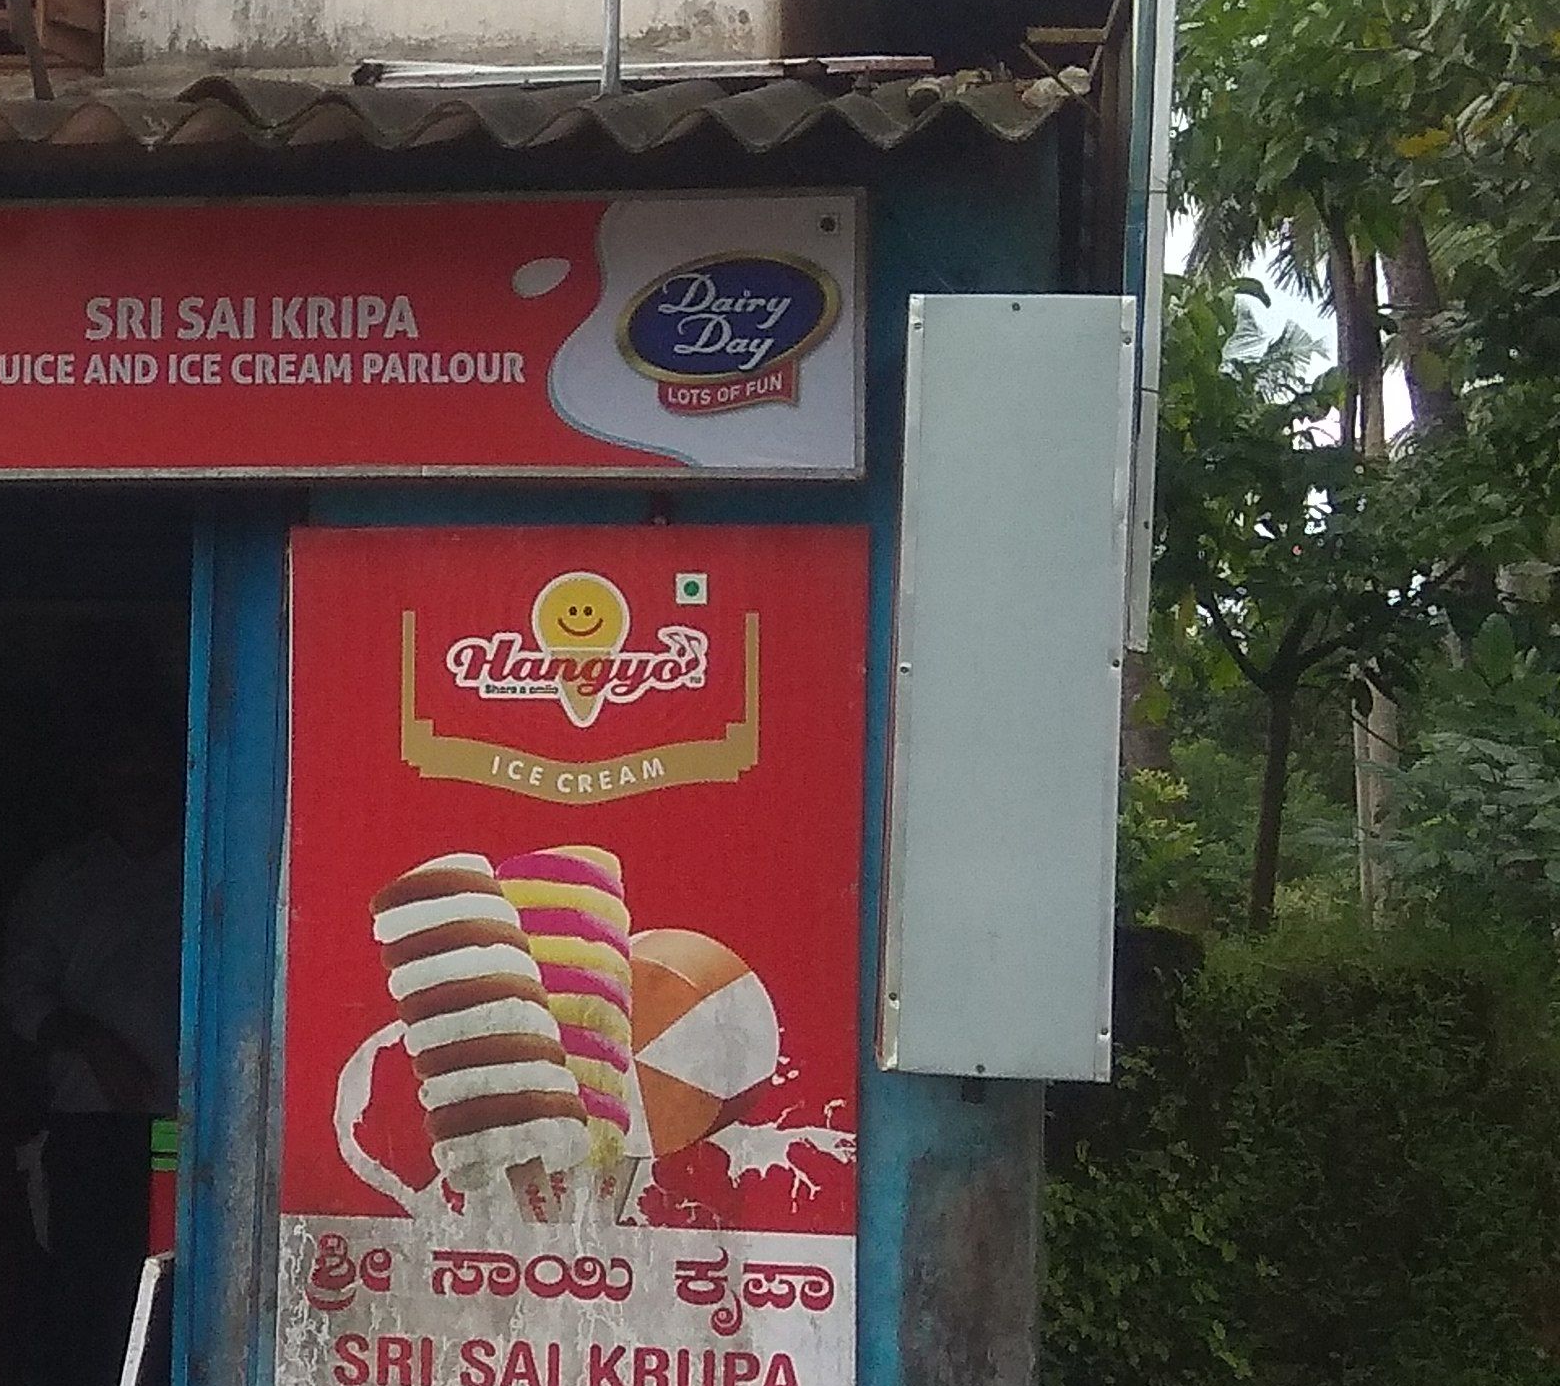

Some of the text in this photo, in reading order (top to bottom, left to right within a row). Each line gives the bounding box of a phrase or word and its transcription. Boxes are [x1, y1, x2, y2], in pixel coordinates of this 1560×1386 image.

[84, 294, 419, 342] SRI SAI KRIPA
[658, 272, 792, 330] Dairy
[84, 354, 158, 385] AND
[167, 354, 222, 385] ICE
[231, 353, 352, 385] CREAM
[362, 352, 526, 384] PARLOUR
[674, 313, 776, 371] Day
[667, 373, 783, 406] LOTS OF FUN
[452, 635, 692, 697] Hangyo
[491, 755, 667, 795] ICE CREAM
[305, 1232, 836, 1336] ಶ್ರೀ ಸಾಯಿ ಕೃಪಾ
